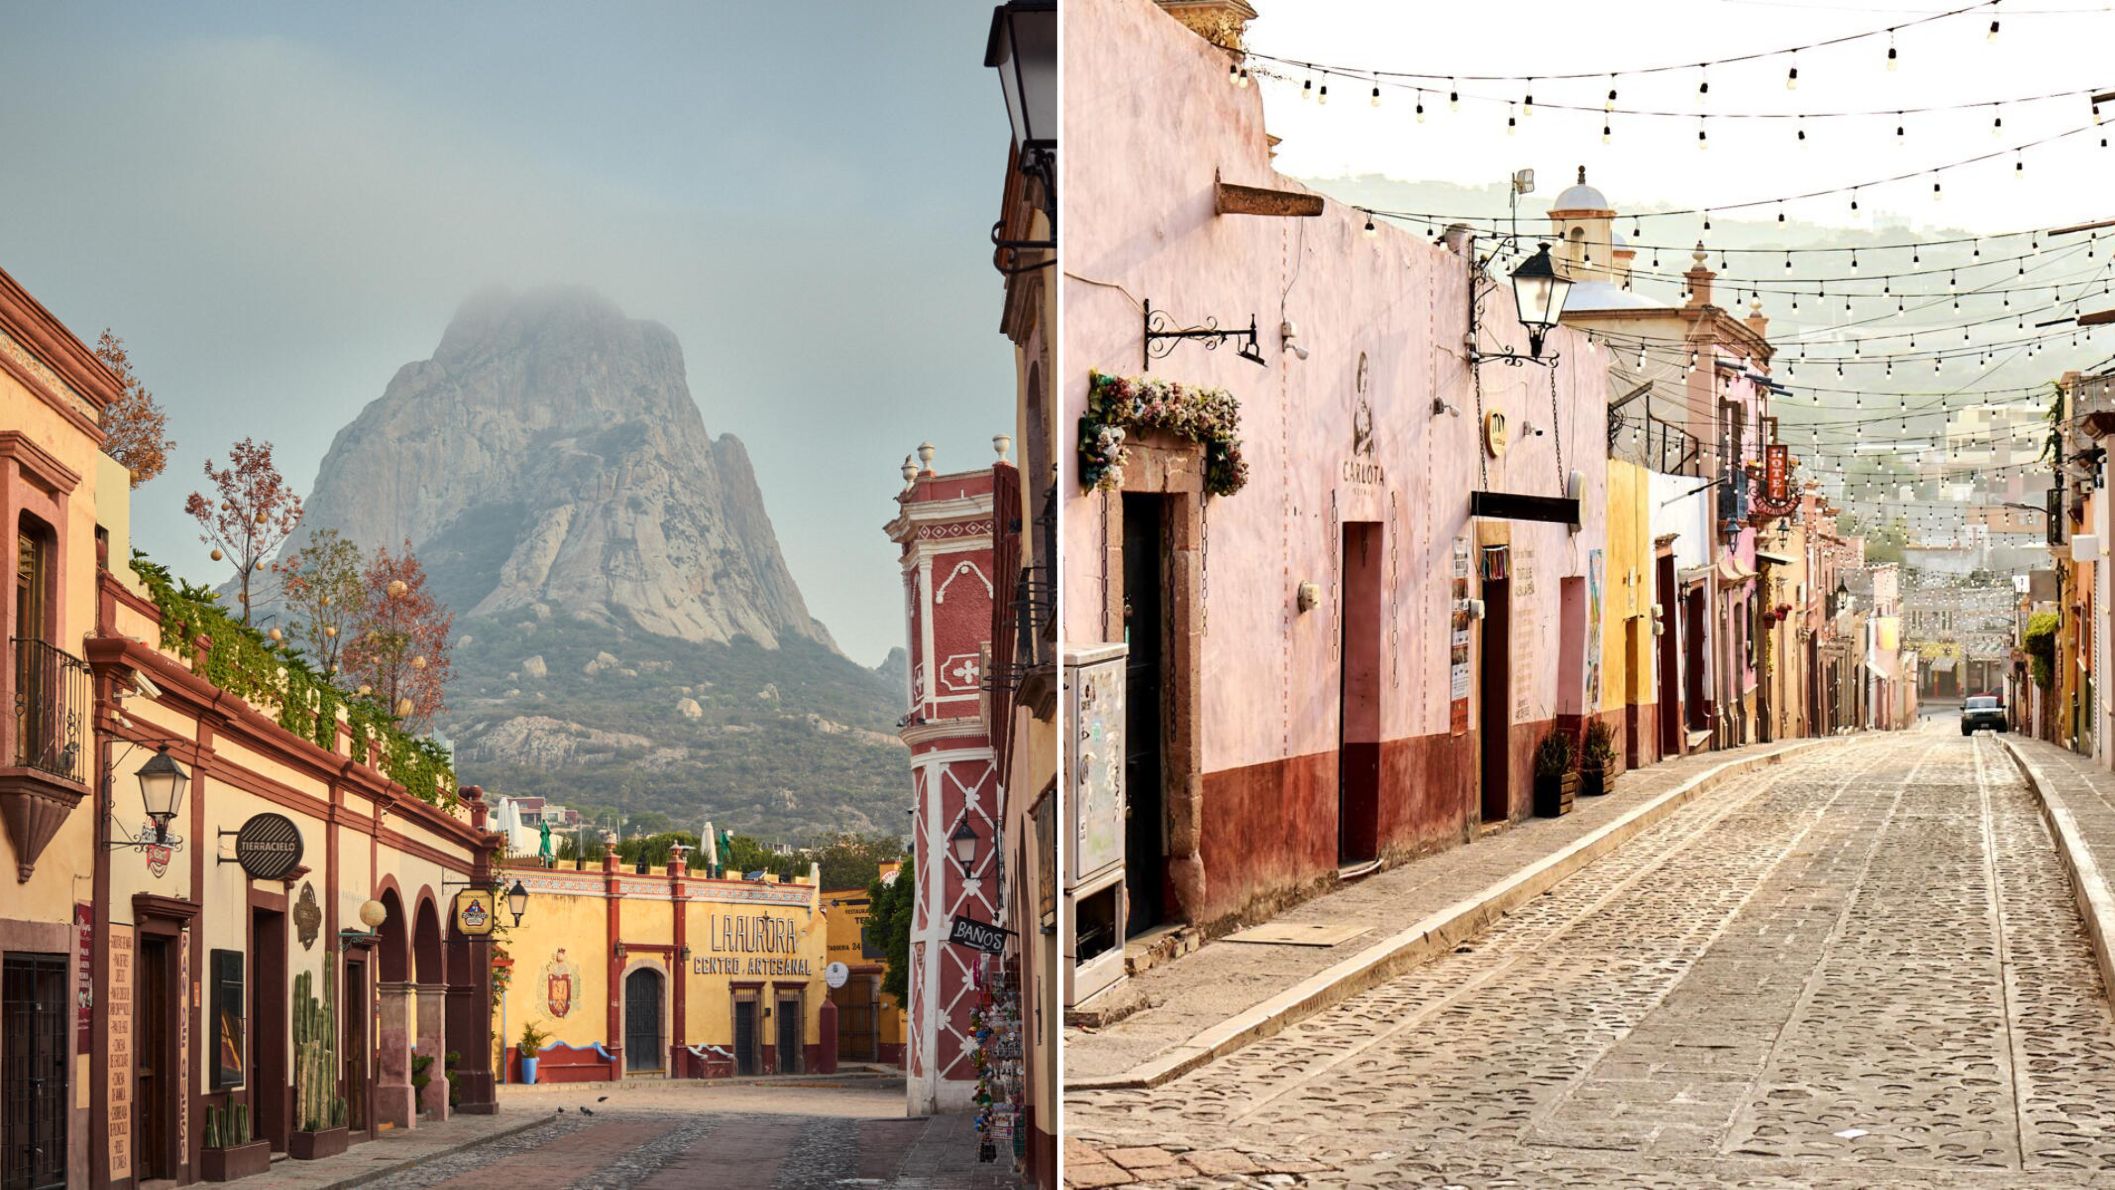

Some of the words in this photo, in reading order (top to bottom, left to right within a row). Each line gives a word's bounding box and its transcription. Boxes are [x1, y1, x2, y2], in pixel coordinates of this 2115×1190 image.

[1343, 461, 1385, 487] CARLOTA
[1771, 449, 1783, 498] HOTEL
[241, 841, 296, 852] TIERRACIELO
[954, 921, 1003, 950] BAÑOS
[694, 956, 740, 976] CENTRO
[747, 957, 812, 976] ARTESANAL
